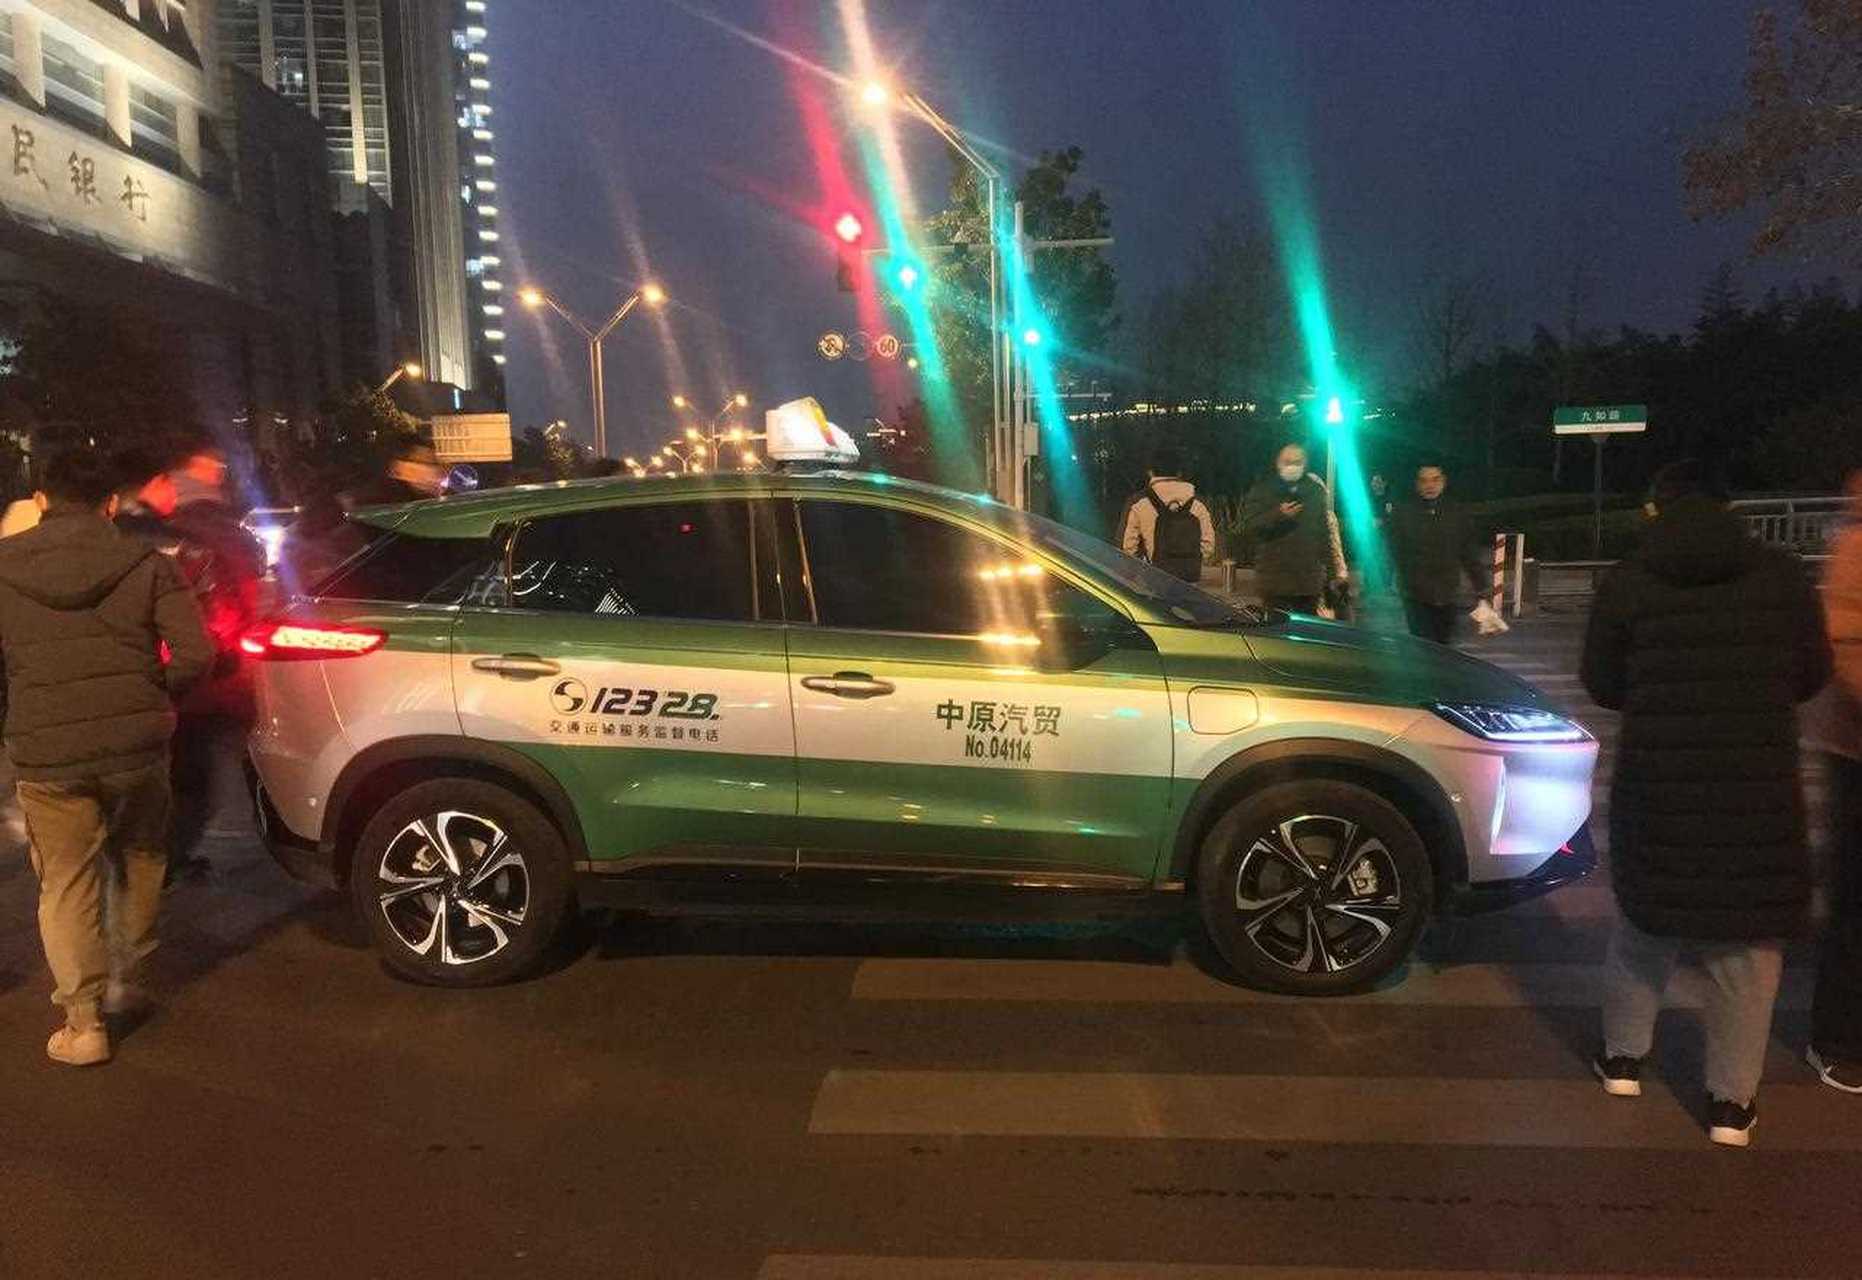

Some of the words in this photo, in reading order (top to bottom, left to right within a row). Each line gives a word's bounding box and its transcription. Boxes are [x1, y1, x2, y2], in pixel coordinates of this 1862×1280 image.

[11, 124, 151, 222] 民银行
[550, 720, 719, 742] 交通运输服务监督电话
[936, 699, 1061, 736] 中原汽贸
[965, 735, 1031, 761] No.04114
